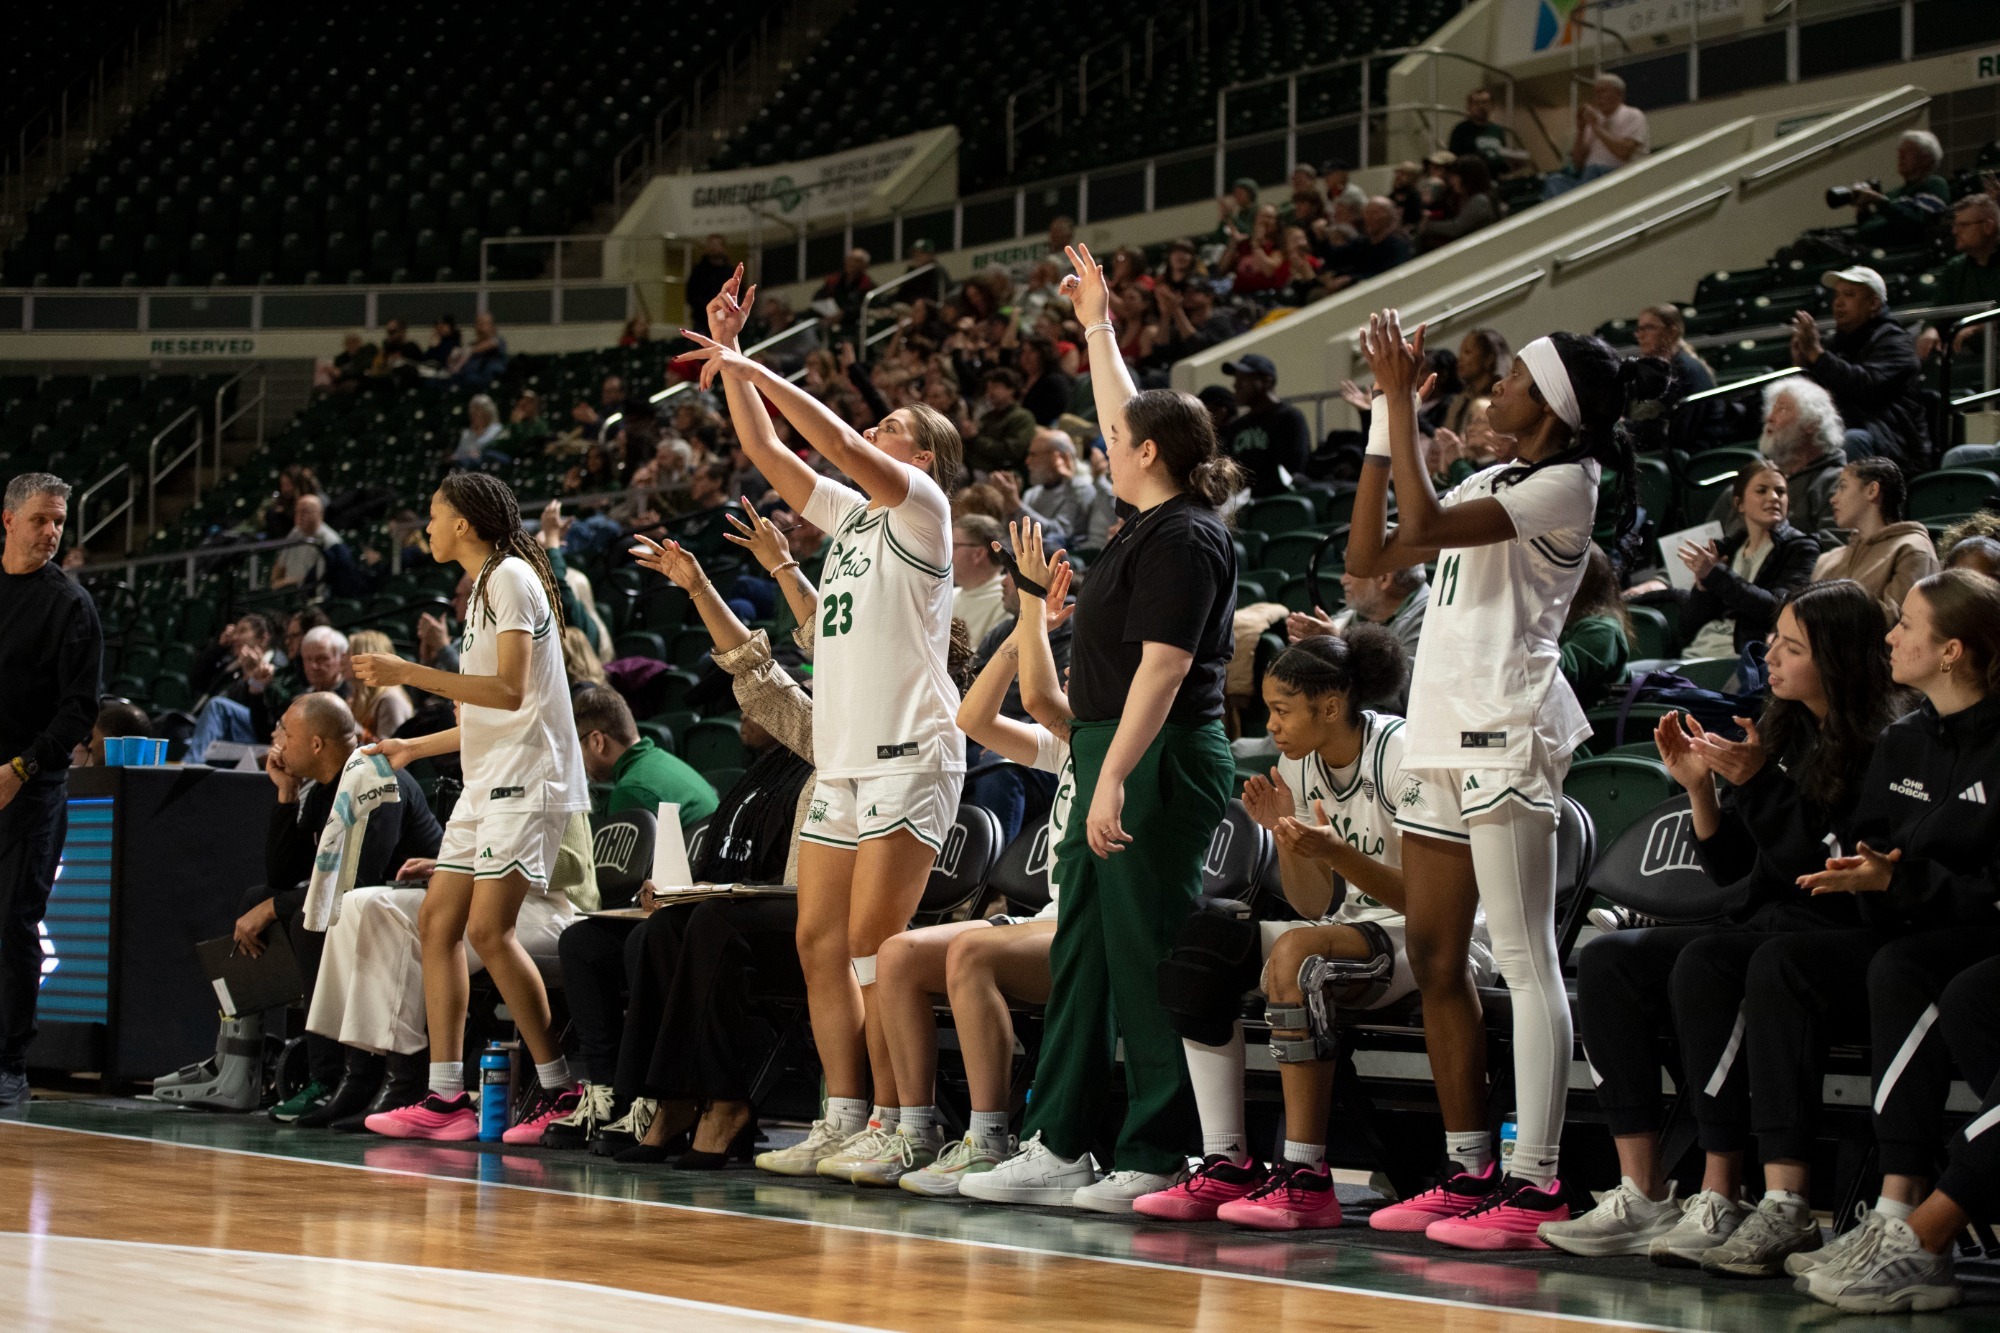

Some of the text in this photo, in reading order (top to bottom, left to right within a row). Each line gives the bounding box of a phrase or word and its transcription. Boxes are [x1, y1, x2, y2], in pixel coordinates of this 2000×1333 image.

[1978, 54, 2000, 78] R
[150, 339, 255, 353] RESERVED
[1437, 553, 1461, 607] 11
[823, 591, 853, 637] 23
[1640, 809, 1705, 876] OH
